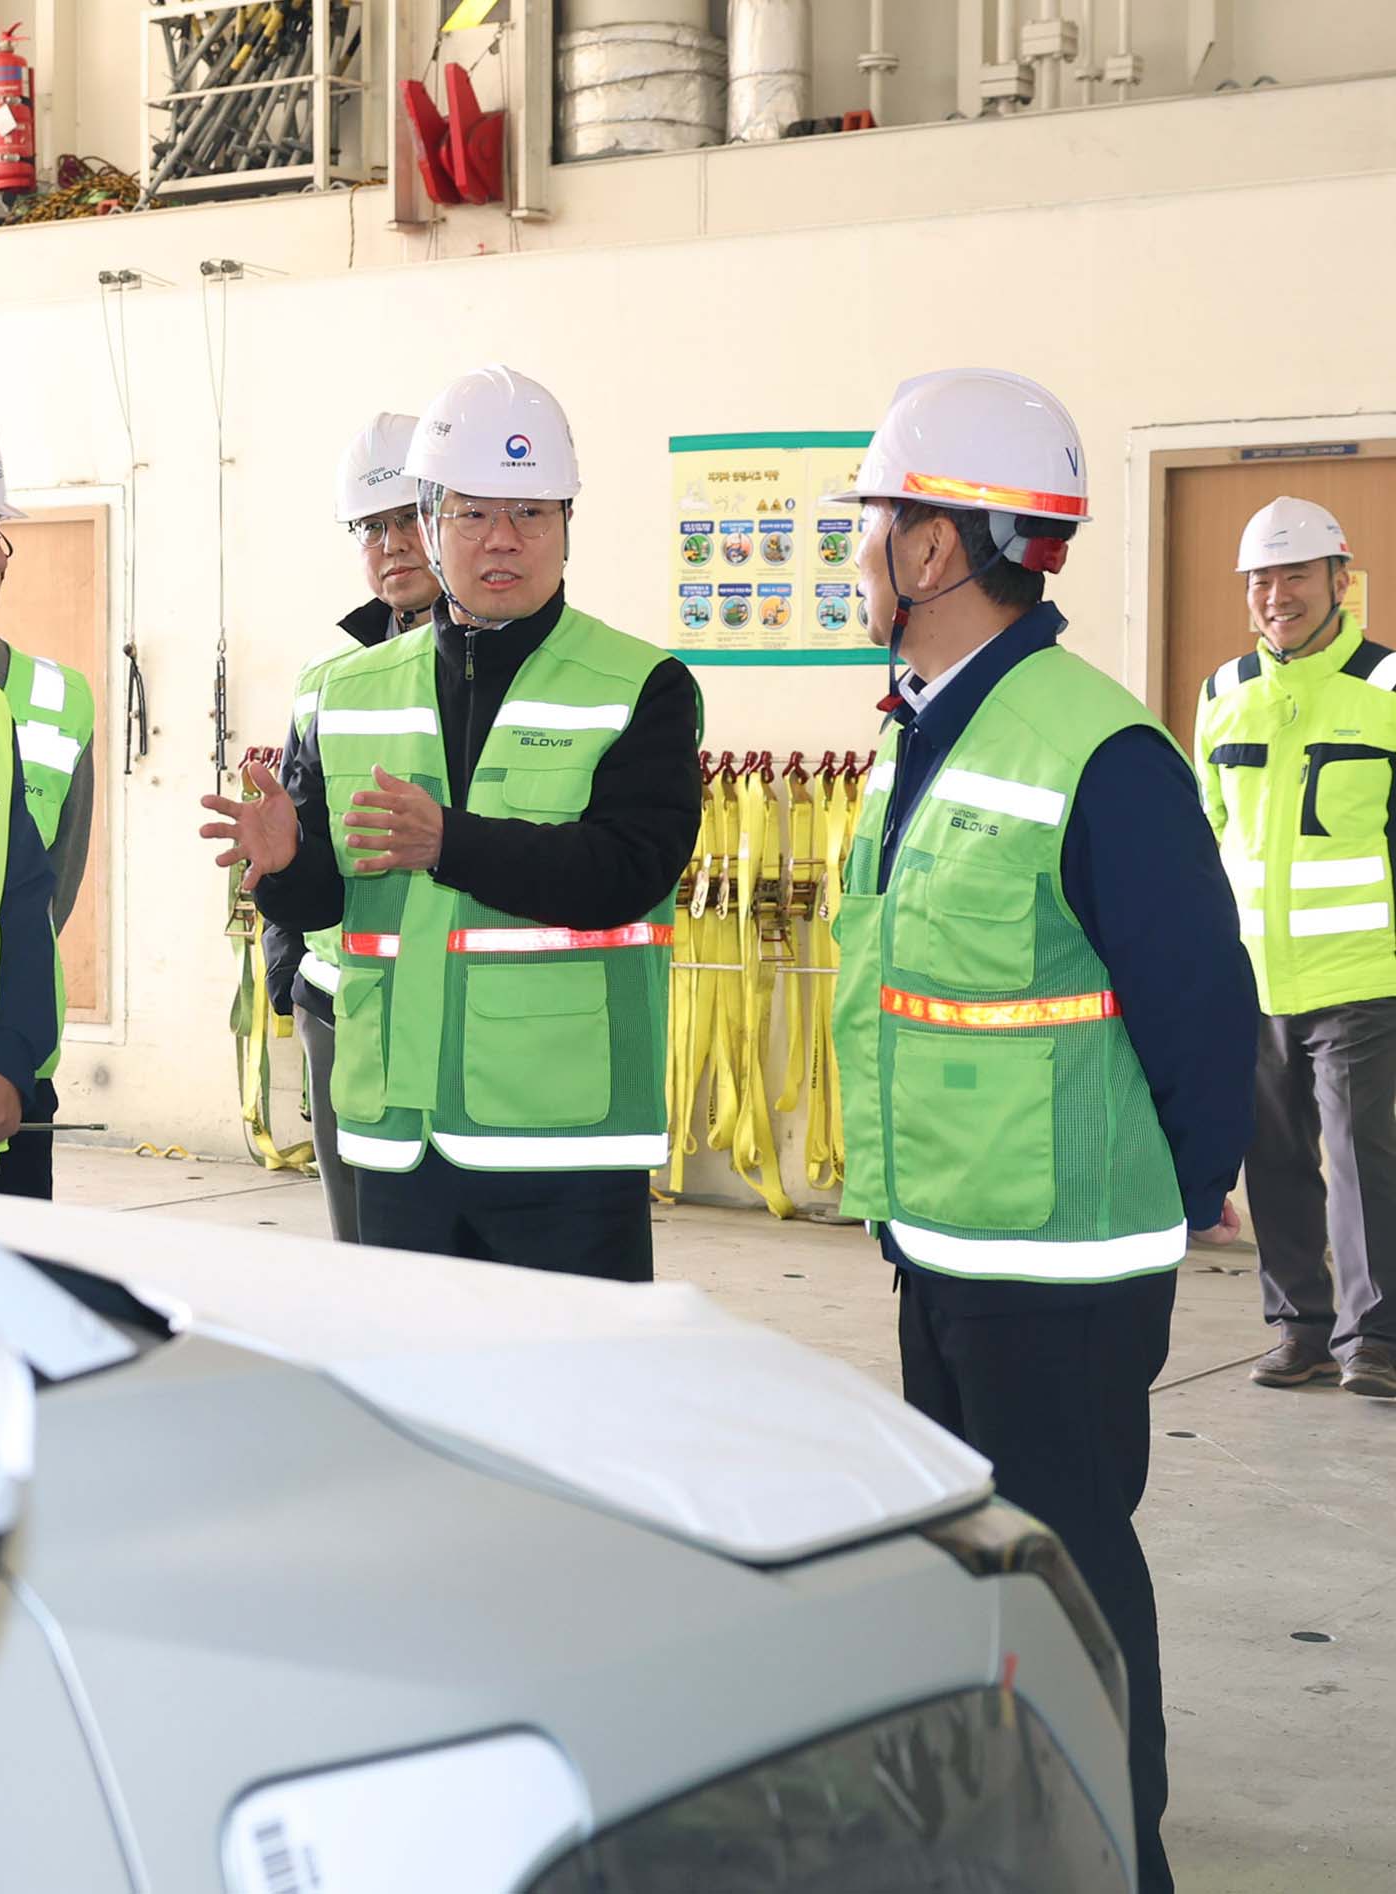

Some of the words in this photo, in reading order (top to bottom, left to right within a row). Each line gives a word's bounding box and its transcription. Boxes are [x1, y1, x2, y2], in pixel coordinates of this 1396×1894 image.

[367, 467, 405, 486] GLOV
[520, 737, 573, 747] GLOVIS
[950, 816, 1000, 836] GLOVIS
